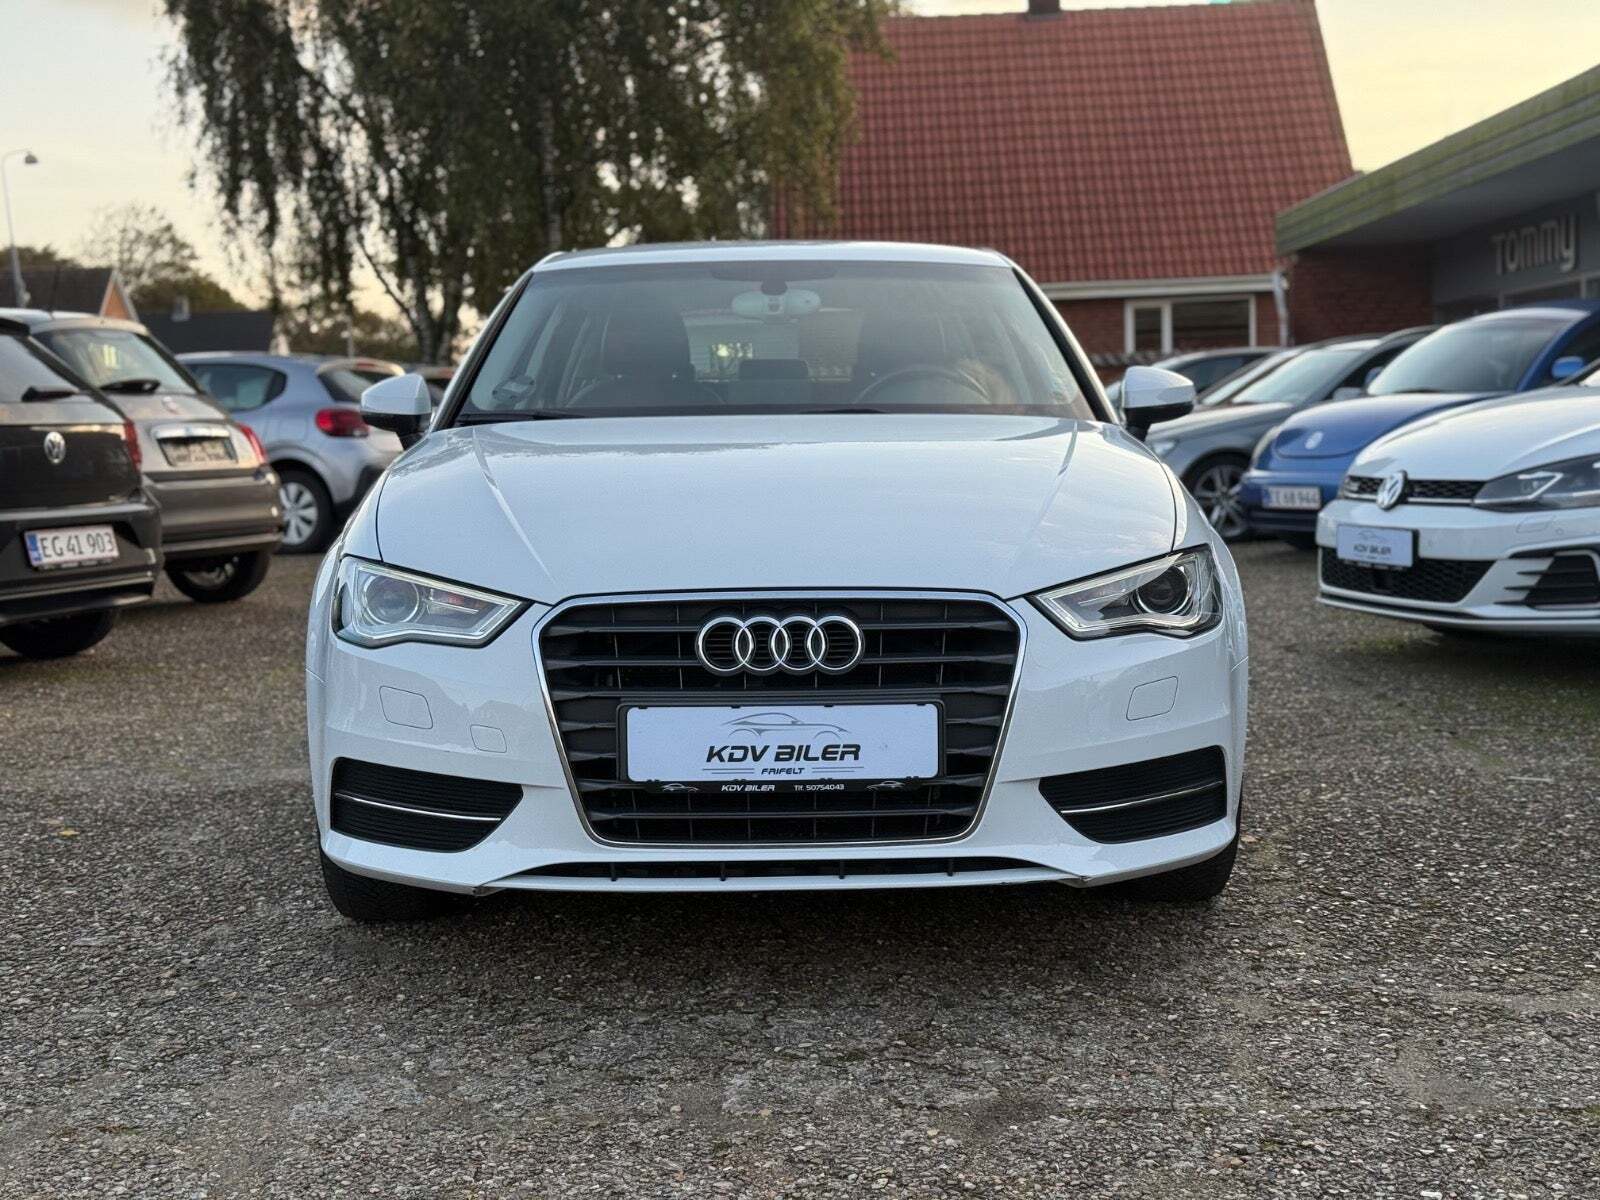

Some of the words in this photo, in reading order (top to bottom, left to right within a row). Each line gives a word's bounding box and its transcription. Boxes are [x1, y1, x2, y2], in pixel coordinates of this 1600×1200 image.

[40, 535, 64, 558] EG
[66, 535, 84, 555] 41
[86, 532, 114, 554] 903
[706, 745, 770, 762] KDV
[774, 744, 861, 762] BILER
[761, 767, 805, 775] FRIFELT
[721, 784, 744, 792] KDV
[744, 784, 776, 792] BILER
[806, 783, 845, 791] 50754043
